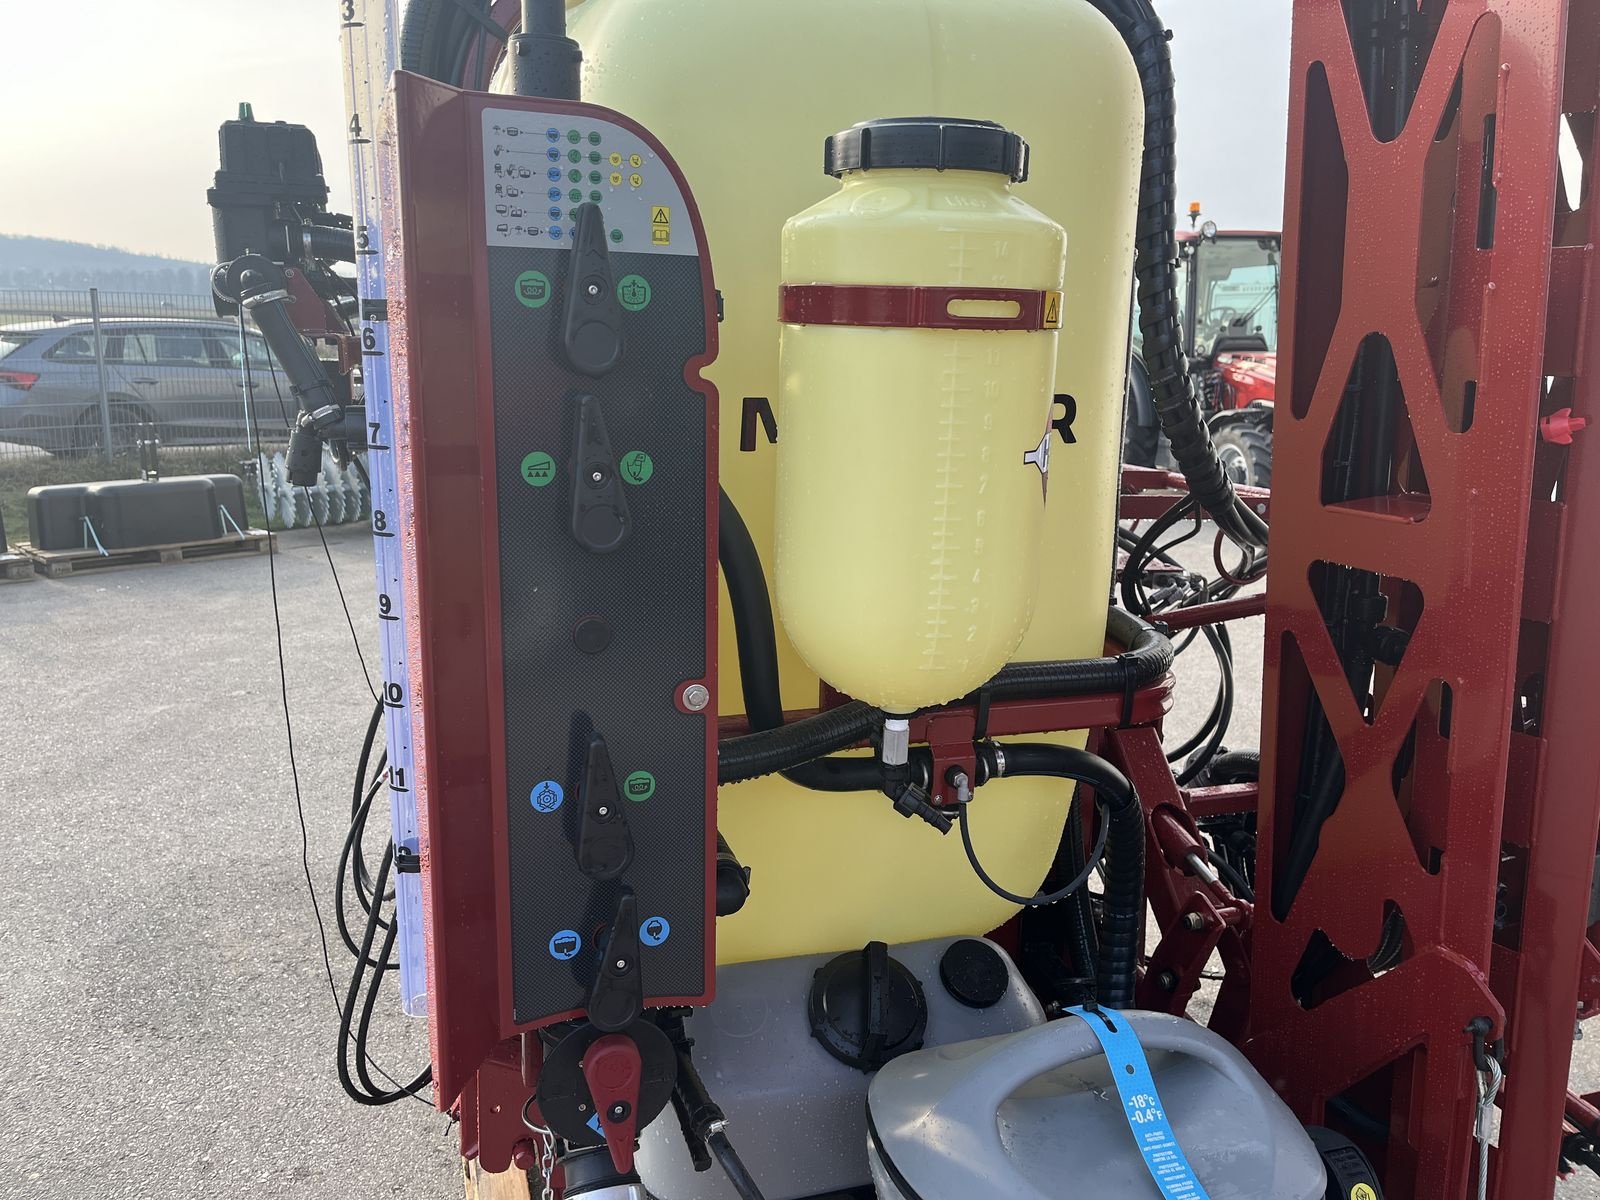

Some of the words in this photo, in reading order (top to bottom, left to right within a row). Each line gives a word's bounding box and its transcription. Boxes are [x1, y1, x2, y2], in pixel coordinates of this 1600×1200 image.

[341, 0, 355, 21] 3
[349, 113, 362, 138] 4
[356, 225, 369, 249] 5
[362, 327, 376, 350] 6
[367, 422, 380, 446] 7
[373, 510, 387, 532] 8
[379, 594, 391, 615] 9
[383, 682, 403, 704] 10
[388, 765, 405, 787] 11
